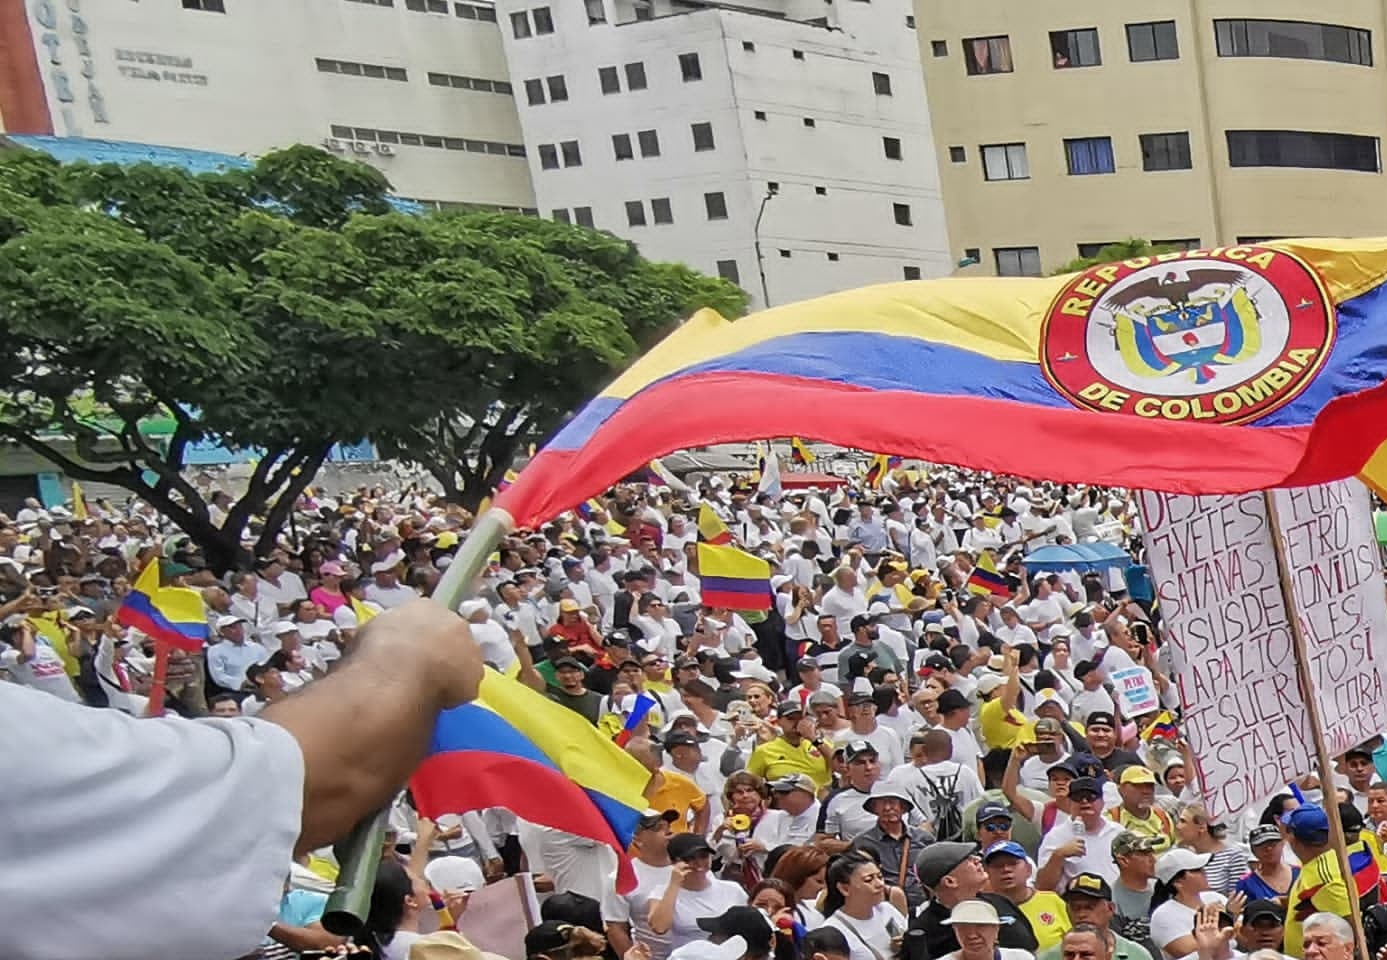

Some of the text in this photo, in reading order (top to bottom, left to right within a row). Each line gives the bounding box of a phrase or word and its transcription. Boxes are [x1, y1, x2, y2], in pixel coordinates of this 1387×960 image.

[1077, 347, 1317, 420] DE COLOMBIA
[1158, 542, 1264, 621] SATANAS
